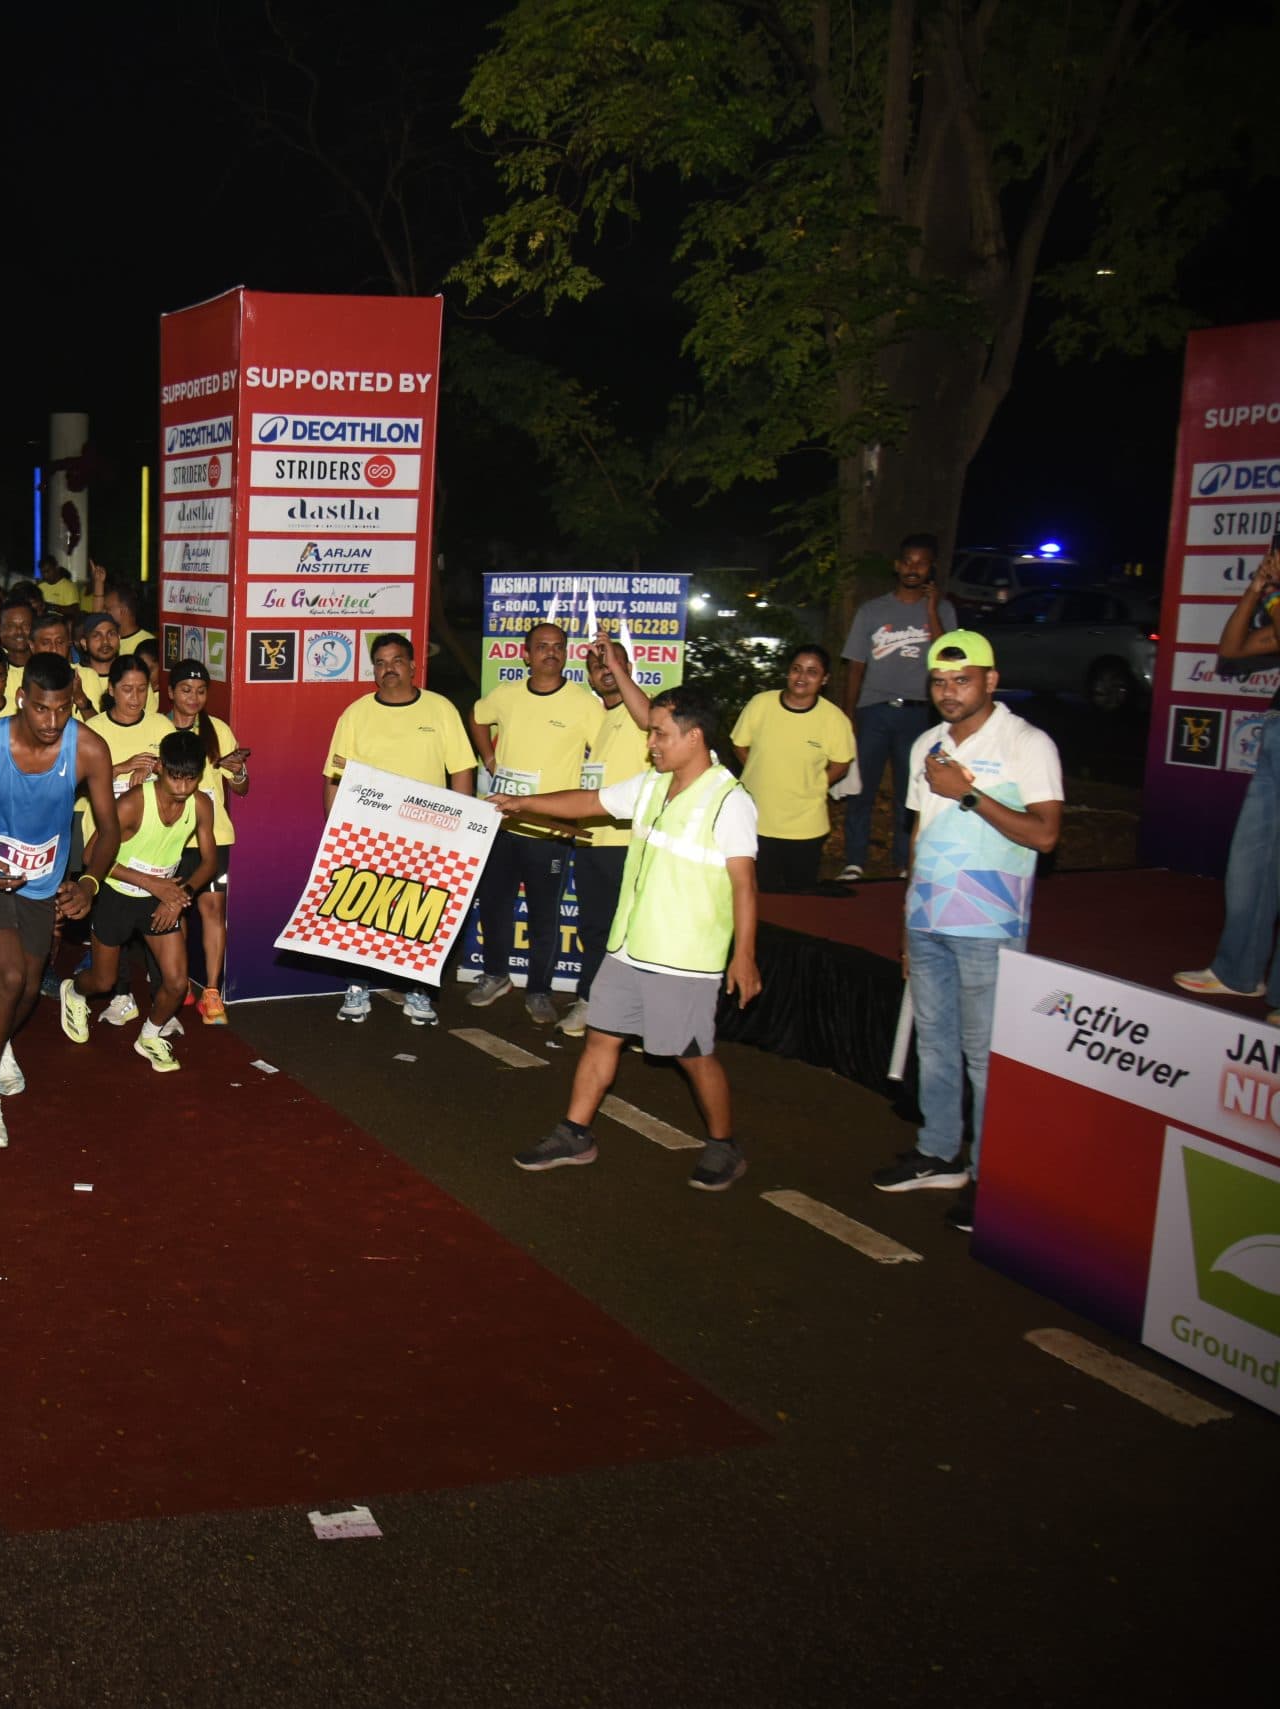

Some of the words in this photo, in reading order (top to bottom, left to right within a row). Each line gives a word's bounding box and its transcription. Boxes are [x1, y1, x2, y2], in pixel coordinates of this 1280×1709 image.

[162, 373, 220, 404] SUPPORTED
[222, 369, 238, 391] BY
[246, 366, 392, 392] SUPPORTED
[399, 373, 432, 393] BY
[179, 421, 232, 448] DECATHLON
[292, 420, 420, 444] DECATHLON
[173, 464, 207, 485] STRIDERS
[275, 459, 362, 481] STRIDERS
[324, 548, 372, 559] ARJAN
[295, 563, 370, 573] INSTITUTE
[491, 577, 537, 594] AKSHAR
[539, 576, 629, 594] INTERNATIONAL
[631, 577, 680, 594] SCHOOL
[492, 600, 540, 613] G-ROAD,
[543, 600, 575, 612] WEST
[630, 601, 677, 614] SONARI
[633, 645, 677, 662] PEN
[500, 668, 524, 681] FOR
[357, 795, 392, 812] Forever
[403, 795, 462, 818] JAMSHEDPUR
[400, 805, 433, 823] NIGHT
[434, 817, 460, 831] RUN
[467, 821, 489, 835] 2025
[7, 846, 48, 871] 1110
[317, 865, 450, 943] 10KM
[1038, 991, 1150, 1045] Active
[1067, 1028, 1190, 1088] Forever
[1171, 1314, 1280, 1389] Ground
